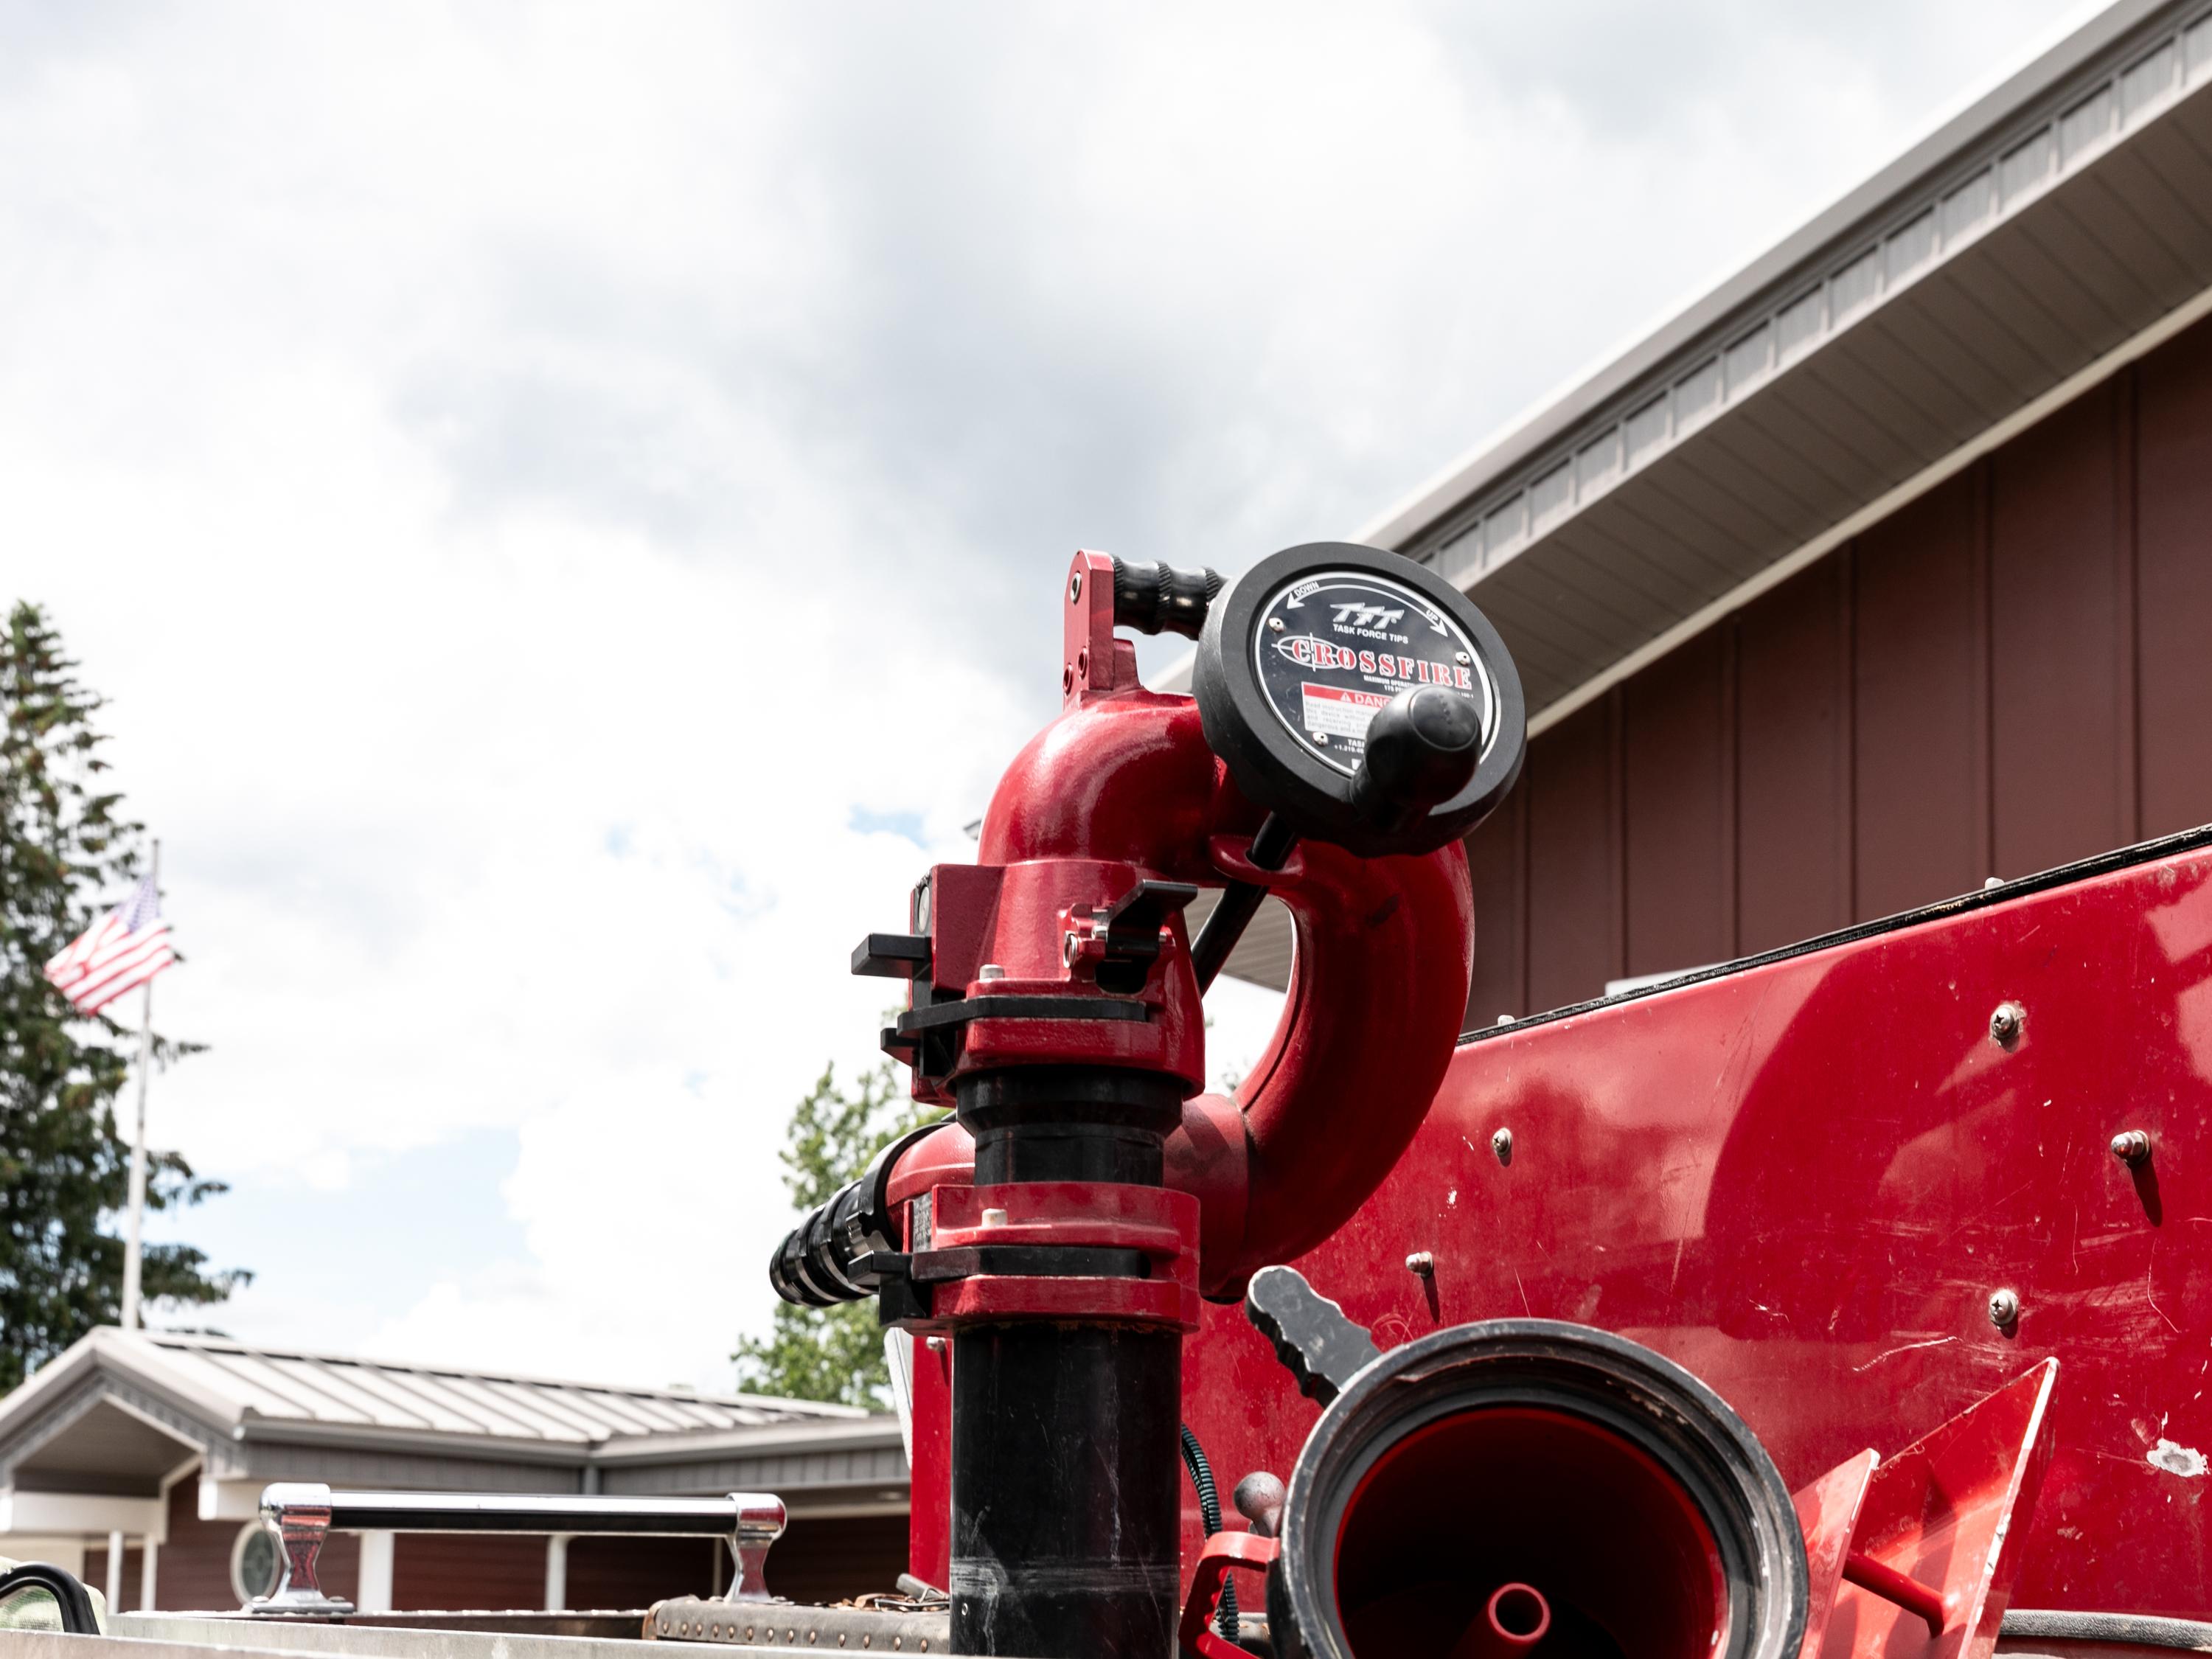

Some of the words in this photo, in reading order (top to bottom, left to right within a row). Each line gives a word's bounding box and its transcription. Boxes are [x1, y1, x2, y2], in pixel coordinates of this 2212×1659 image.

[1294, 581, 1320, 597] DOWN
[1426, 609, 1439, 621] UP
[1333, 623, 1356, 636] TASK
[1357, 627, 1387, 640] FORCE
[1389, 633, 1409, 644] TIPS
[1291, 639, 1473, 690] CROSSFIRE
[1363, 675, 1390, 685] MAXIMUM
